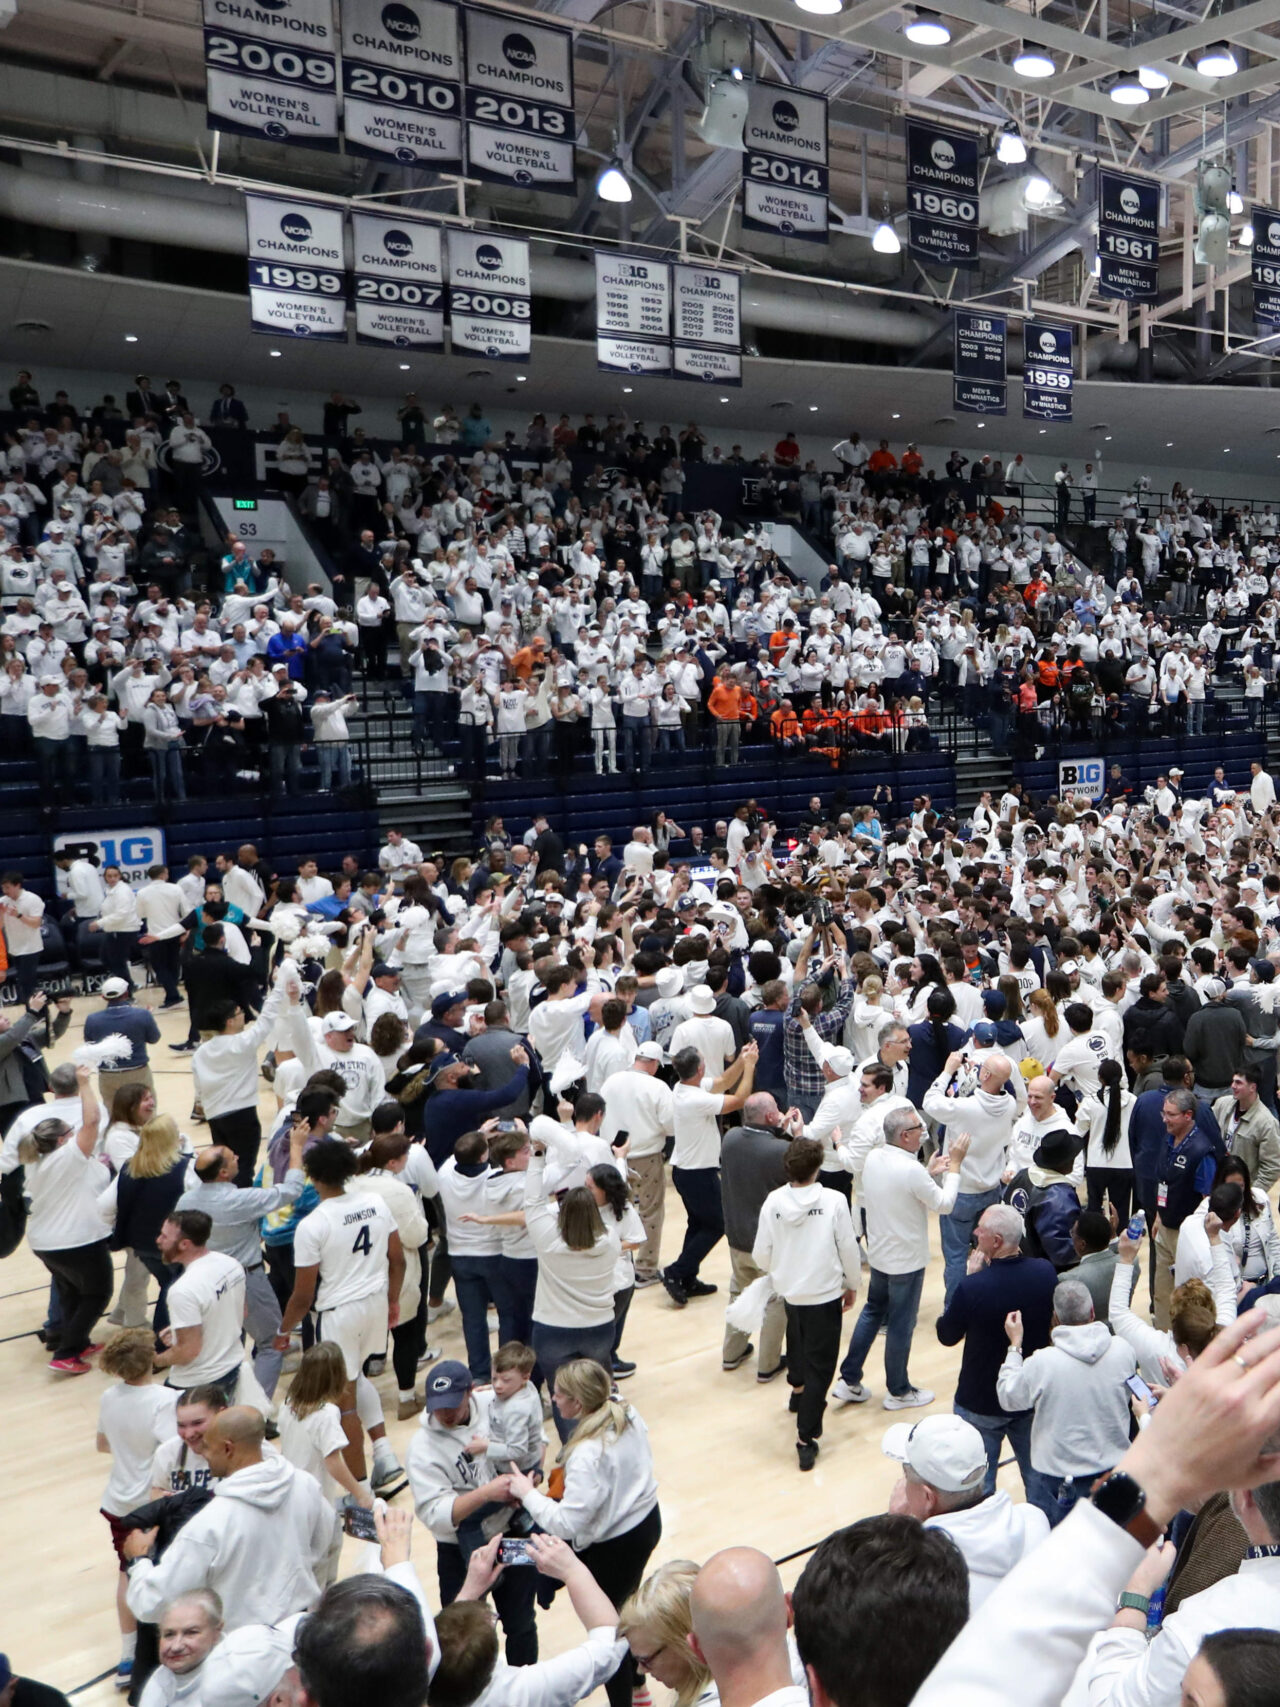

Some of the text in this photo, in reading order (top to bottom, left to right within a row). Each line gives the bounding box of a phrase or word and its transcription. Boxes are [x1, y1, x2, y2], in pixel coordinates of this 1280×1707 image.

[214, 1, 328, 38] CHAMPIONS
[352, 33, 453, 66] CHAMPIONS
[208, 36, 335, 84] 2009
[476, 62, 564, 93] CHAMPIONS
[350, 68, 455, 110] 2010
[240, 88, 310, 112] WOMEN'S
[229, 98, 320, 126] VOLLEYBALL
[475, 95, 565, 135] 2013
[373, 116, 437, 137] WOMEN'S
[364, 125, 447, 150] VOLLEYBALL
[751, 127, 821, 151] CHAMPIONS
[494, 140, 550, 160] WOMEN'S
[485, 150, 559, 172] VOLLEYBALL
[750, 157, 821, 188] 2014
[913, 165, 974, 187] CHAMPIONS
[765, 195, 809, 212] WOMEN'S
[912, 192, 975, 221] 1960
[758, 204, 815, 223] VOLLEYBALL
[1105, 211, 1155, 229] CHAMPIONS
[918, 235, 970, 252] GYMNASTICS
[931, 229, 958, 241] MEN'S
[257, 238, 339, 259] CHAMPIONS
[1106, 236, 1152, 260] 1961
[362, 254, 437, 273] CHAMPIONS
[256, 266, 341, 293] 1999
[456, 268, 526, 286] CHAMPIONS
[1108, 274, 1150, 288] GYMNASTICS
[1119, 268, 1139, 279] MEN'S
[602, 275, 665, 291] CHAMPIONS
[357, 280, 442, 305] 2007
[680, 286, 735, 302] CHAMPIONS
[275, 301, 327, 314] WOMEN'S
[451, 293, 531, 318] 2008
[267, 309, 334, 324] VOLLEYBALL
[377, 313, 426, 327] WOMEN'S
[370, 321, 432, 336] VOLLEYBALL
[471, 325, 514, 338] WOMEN'S
[959, 329, 1003, 342] CHAMPIONS
[464, 333, 521, 346] VOLLEYBALL
[615, 343, 654, 354] WOMEN'S
[609, 352, 660, 363] VOLLEYBALL
[685, 360, 731, 371] VOLLEYBALL
[691, 353, 726, 363] WOMEN'S
[1028, 351, 1070, 364] CHAMPIONS
[1027, 370, 1070, 388] 1959
[962, 393, 1000, 403] GYMNASTICS
[972, 387, 990, 395] MEN'S
[1040, 395, 1057, 403] MEN'S
[1031, 401, 1067, 410] GYMNASTICS
[235, 500, 255, 508] EXIT
[239, 523, 257, 536] S3
[343, 1207, 377, 1225] JOHNSON
[352, 1225, 372, 1255] 4
